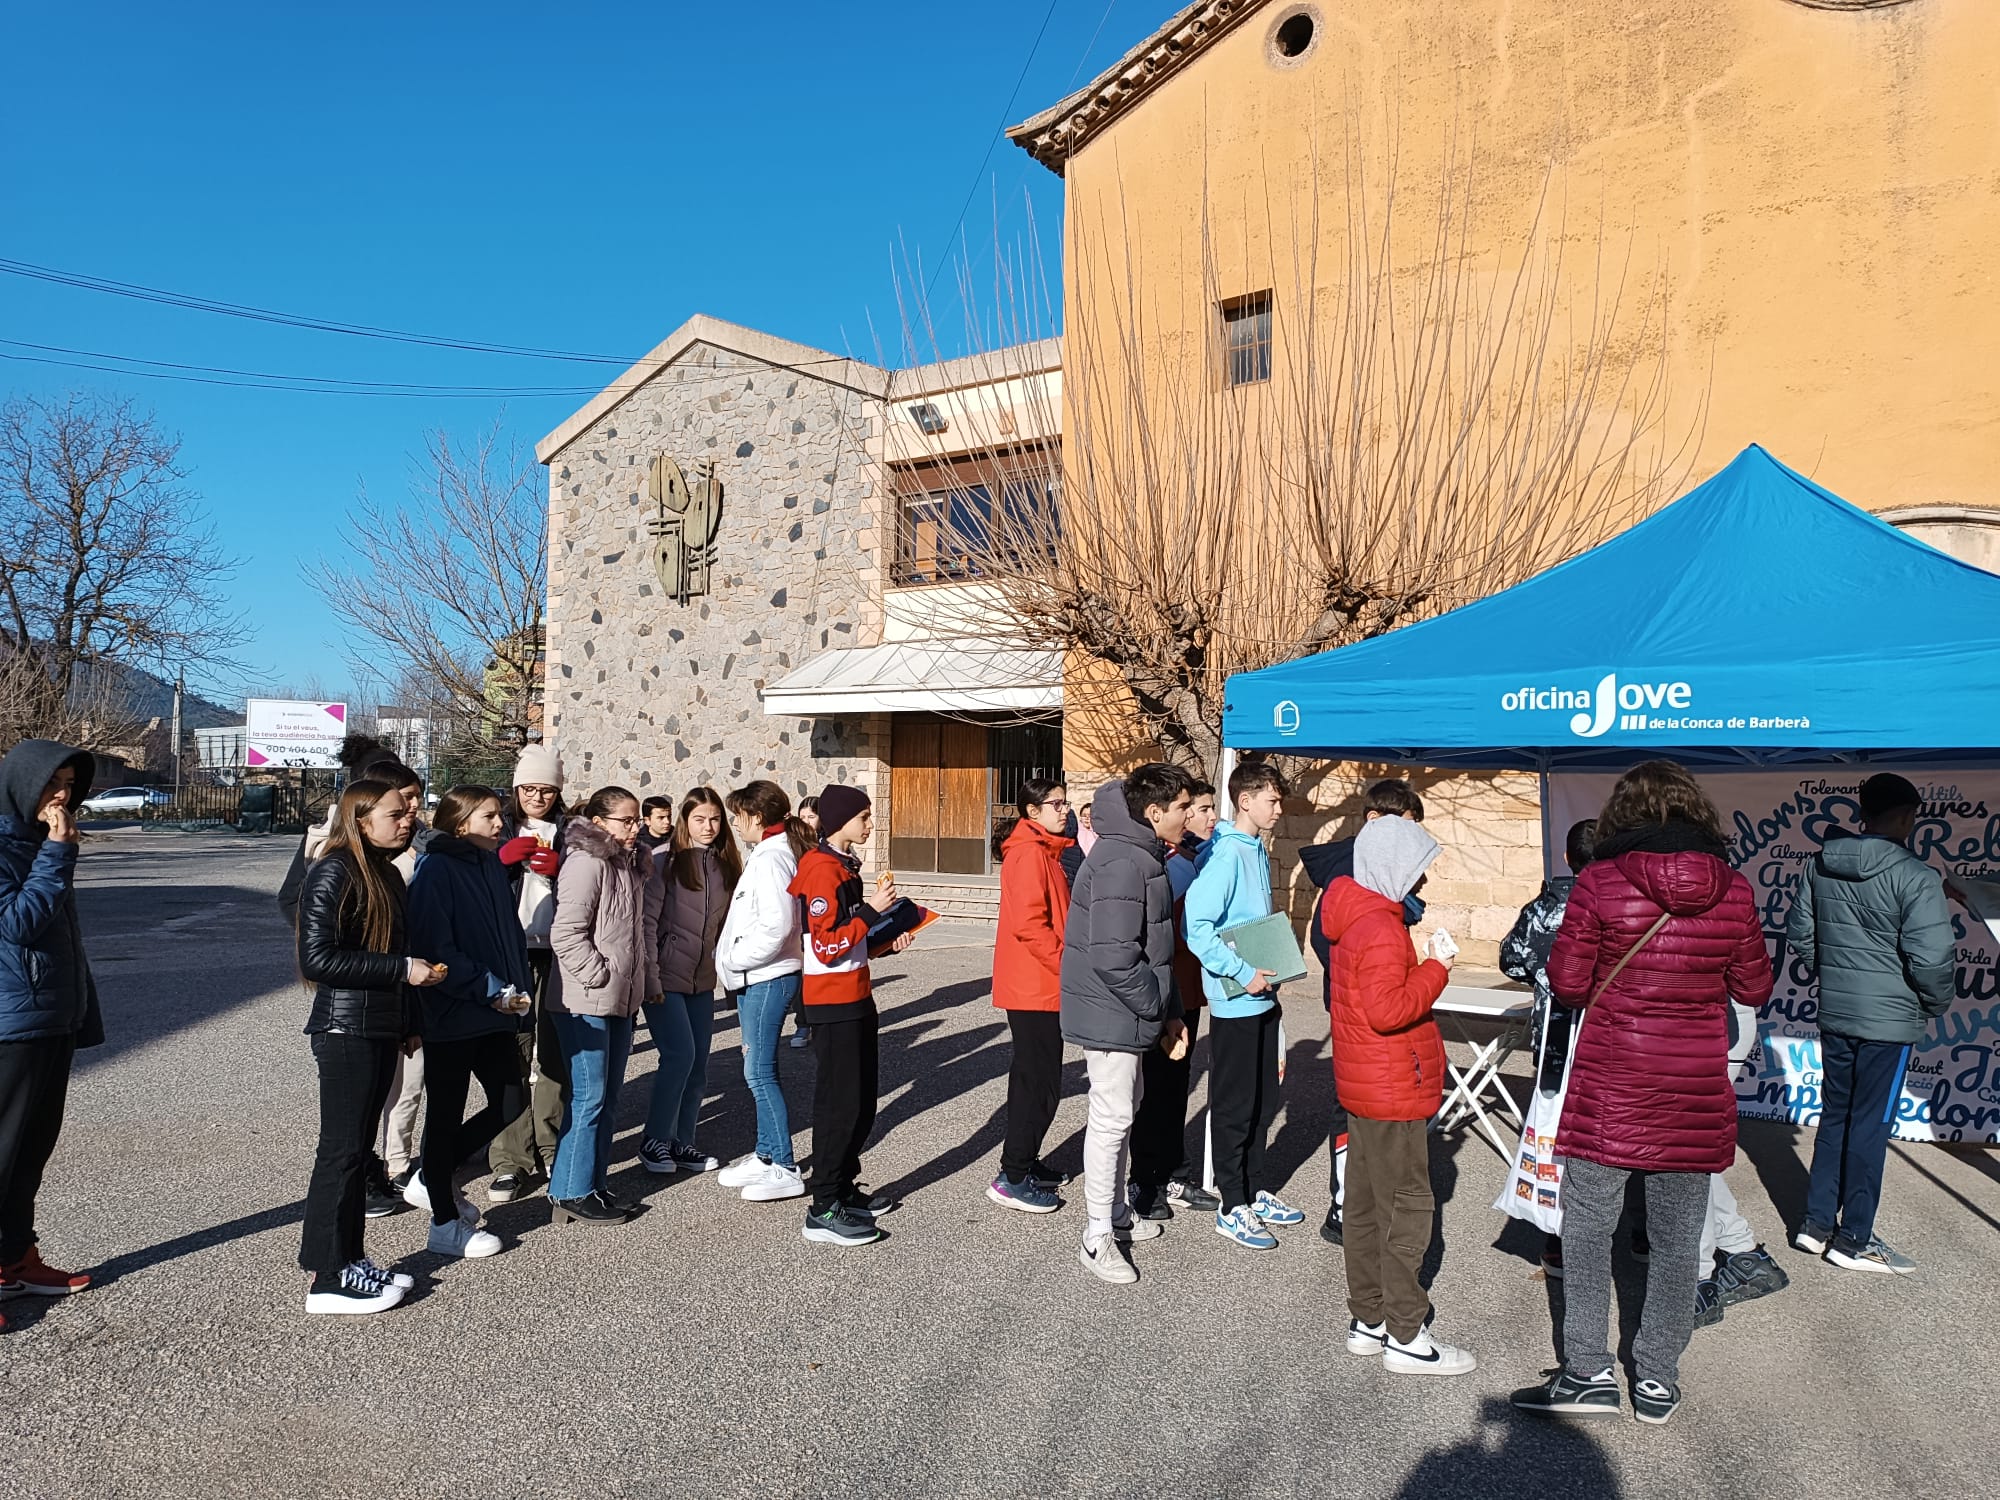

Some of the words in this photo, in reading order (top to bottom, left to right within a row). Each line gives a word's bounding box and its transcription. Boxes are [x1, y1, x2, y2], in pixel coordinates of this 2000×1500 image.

[1501, 686, 1591, 711] oficina
[1569, 672, 1692, 738] Jove
[1649, 717, 1666, 729] de
[1667, 717, 1679, 729] la
[1680, 717, 1724, 729] Conca
[1727, 717, 1745, 729] de
[1749, 716, 1810, 729] Barberà
[266, 744, 286, 753] 900
[289, 745, 307, 754] 406
[310, 746, 329, 755] 600
